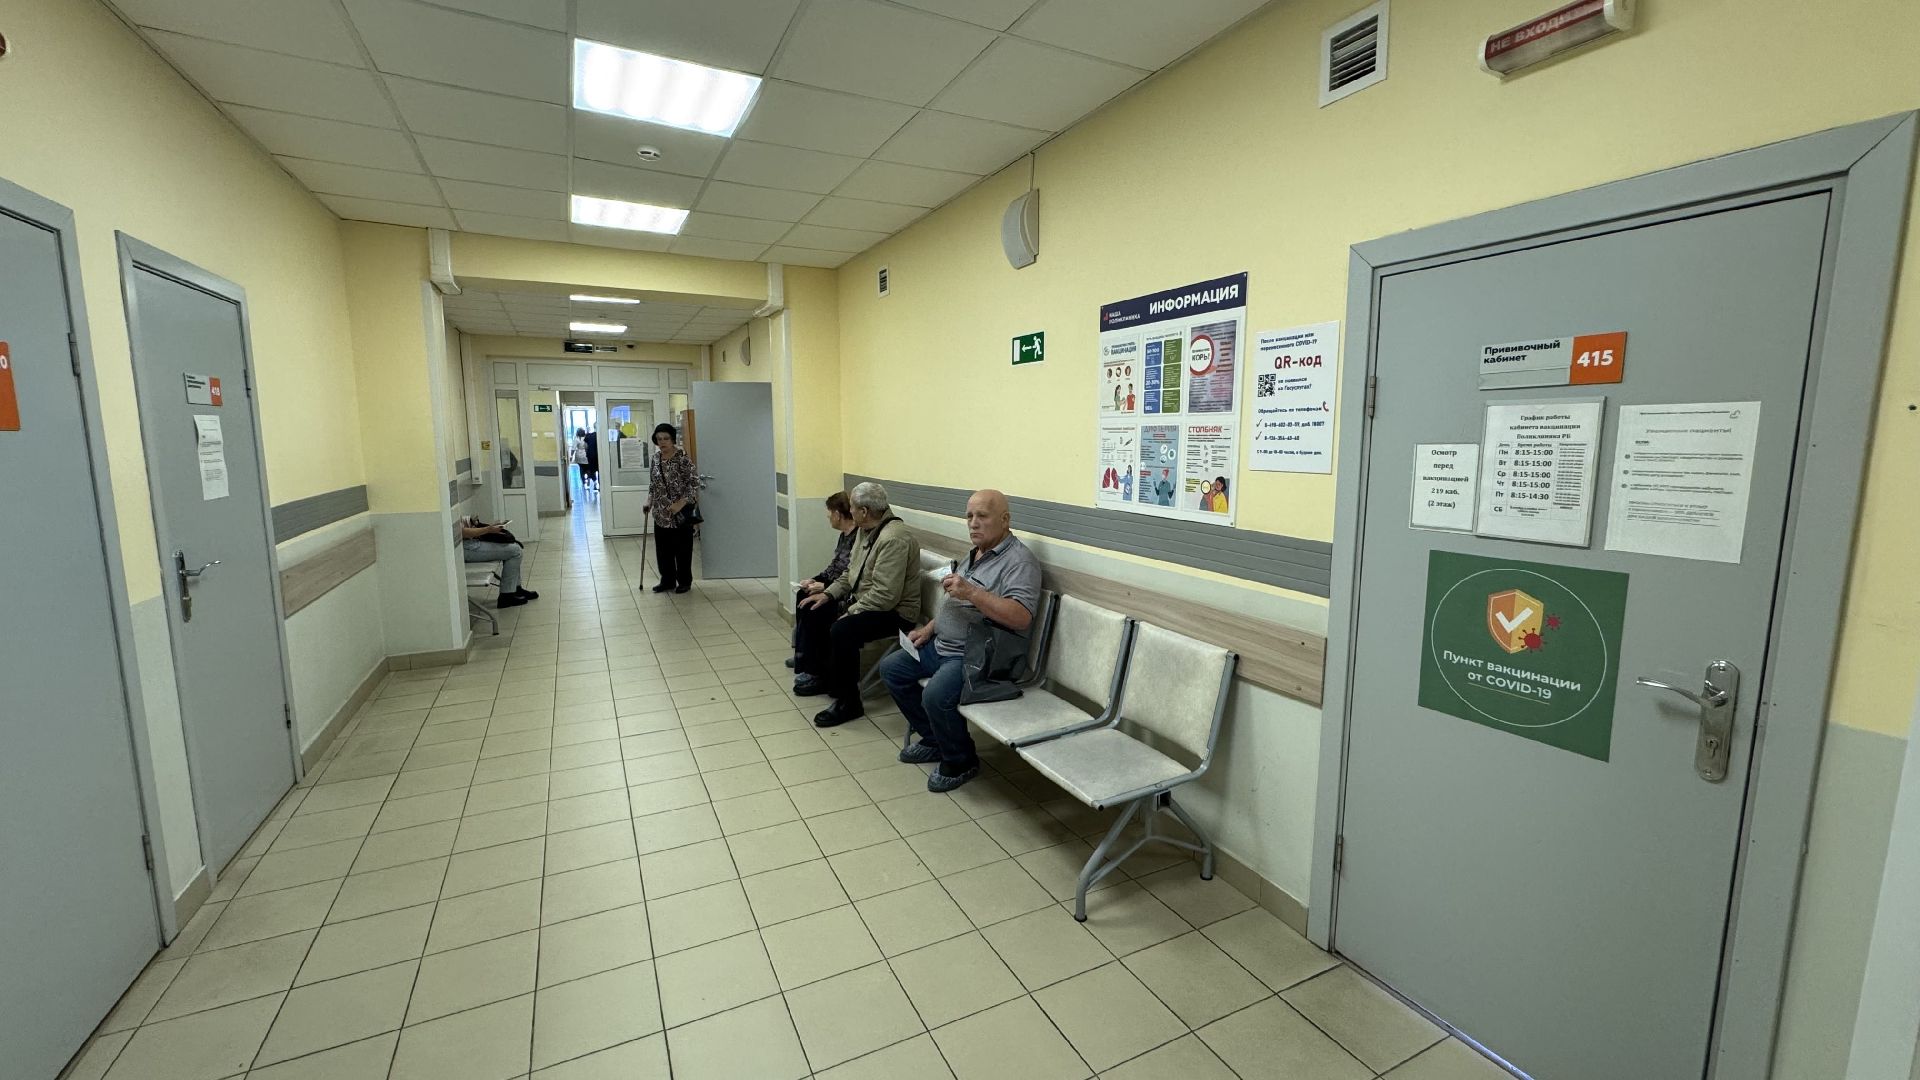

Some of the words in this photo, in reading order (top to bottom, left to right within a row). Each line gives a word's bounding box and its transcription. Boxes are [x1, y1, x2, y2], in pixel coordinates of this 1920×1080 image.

[1490, 37, 1512, 52] НЕ
[1149, 284, 1239, 315] ИНФОРМАЦИЯ
[1295, 339, 1317, 347] COVID-19
[1192, 352, 1210, 361] КОРЬ!
[1483, 354, 1527, 364] кабинет
[1484, 340, 1560, 356] Прививочный
[1577, 350, 1613, 367] 415
[1274, 355, 1322, 369] QR-код
[1431, 449, 1457, 457] Осмотр
[1510, 492, 1549, 500] 8:15-14:30
[1428, 500, 1435, 508] (2
[1435, 501, 1455, 509] этаж)
[1443, 650, 1484, 669] Пункт
[1487, 662, 1581, 692] вакцинации
[1467, 671, 1483, 682] от
[1485, 675, 1552, 700] COVID-19
